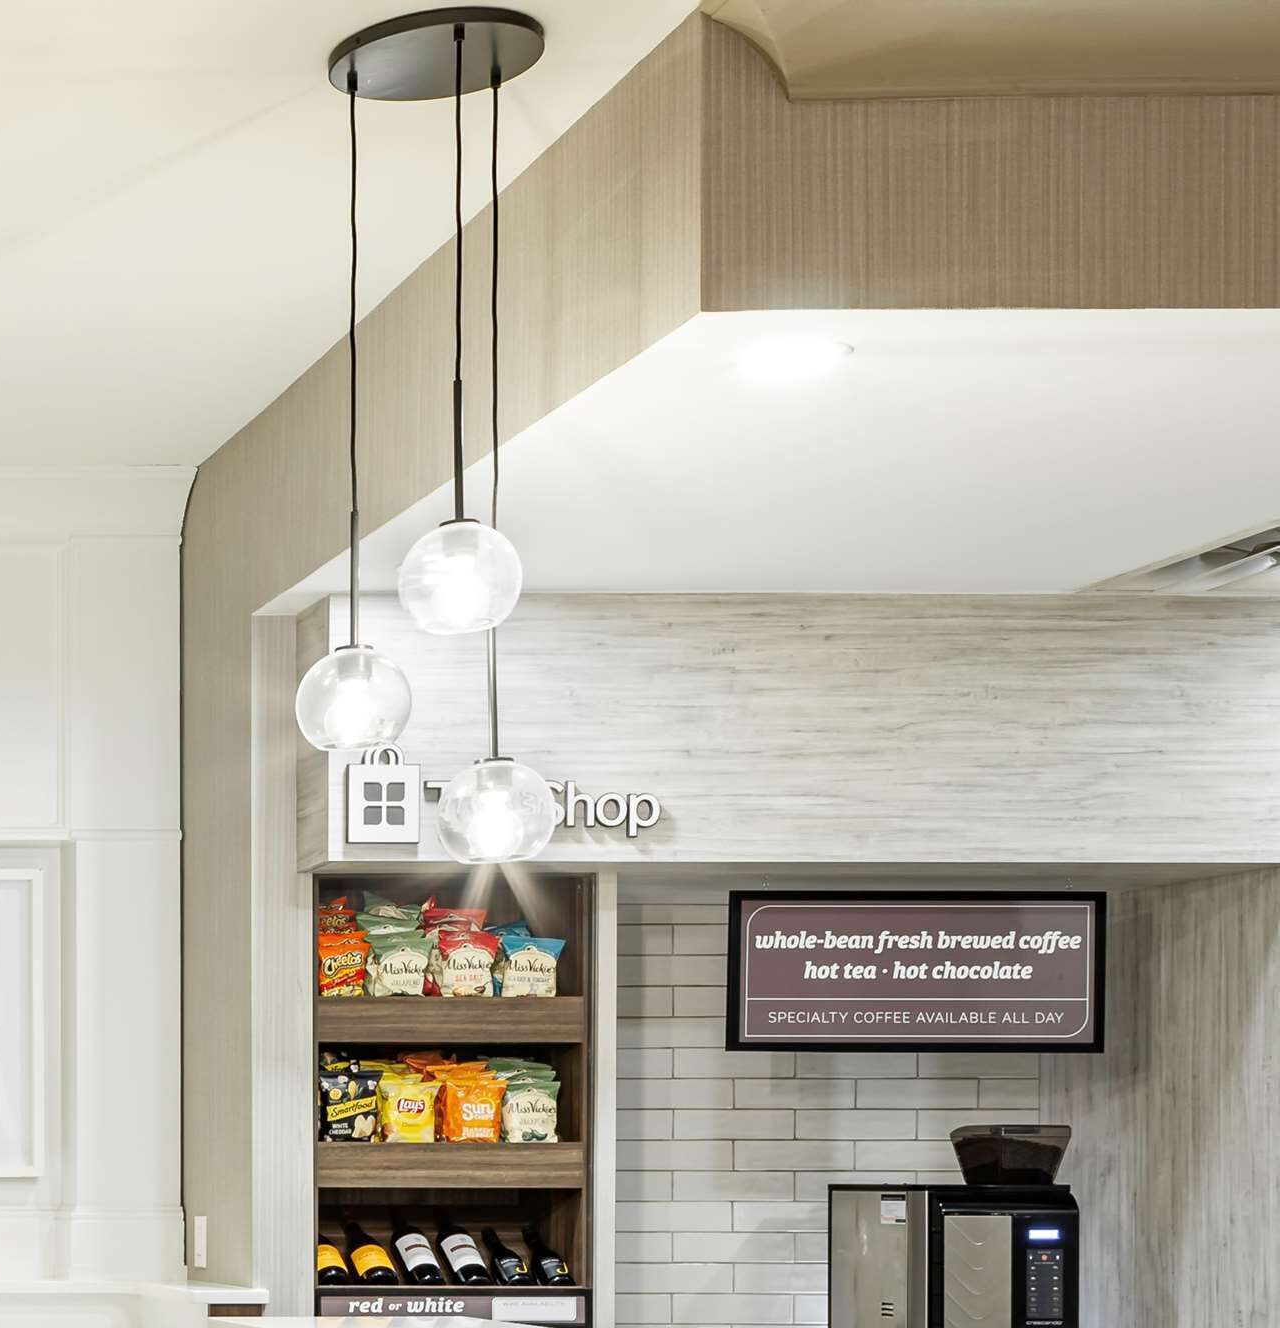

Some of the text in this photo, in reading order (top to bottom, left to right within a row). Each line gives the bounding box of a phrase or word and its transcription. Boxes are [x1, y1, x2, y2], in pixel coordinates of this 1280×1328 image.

[754, 930, 1082, 954] whole-bean fresh brewed coffee
[322, 952, 362, 978] Cheetos
[444, 958, 466, 972] Miss
[508, 958, 528, 972] Miss
[803, 961, 1034, 980] hot tea hot chocolate
[768, 1012, 1065, 1024] SPECIALTY COFFEE AVAILABLE ALL DAY
[330, 1099, 374, 1118] Smartfood
[462, 1103, 494, 1120] Sun
[508, 1102, 530, 1114] Miss
[348, 1298, 384, 1313] red
[406, 1296, 465, 1313] white
